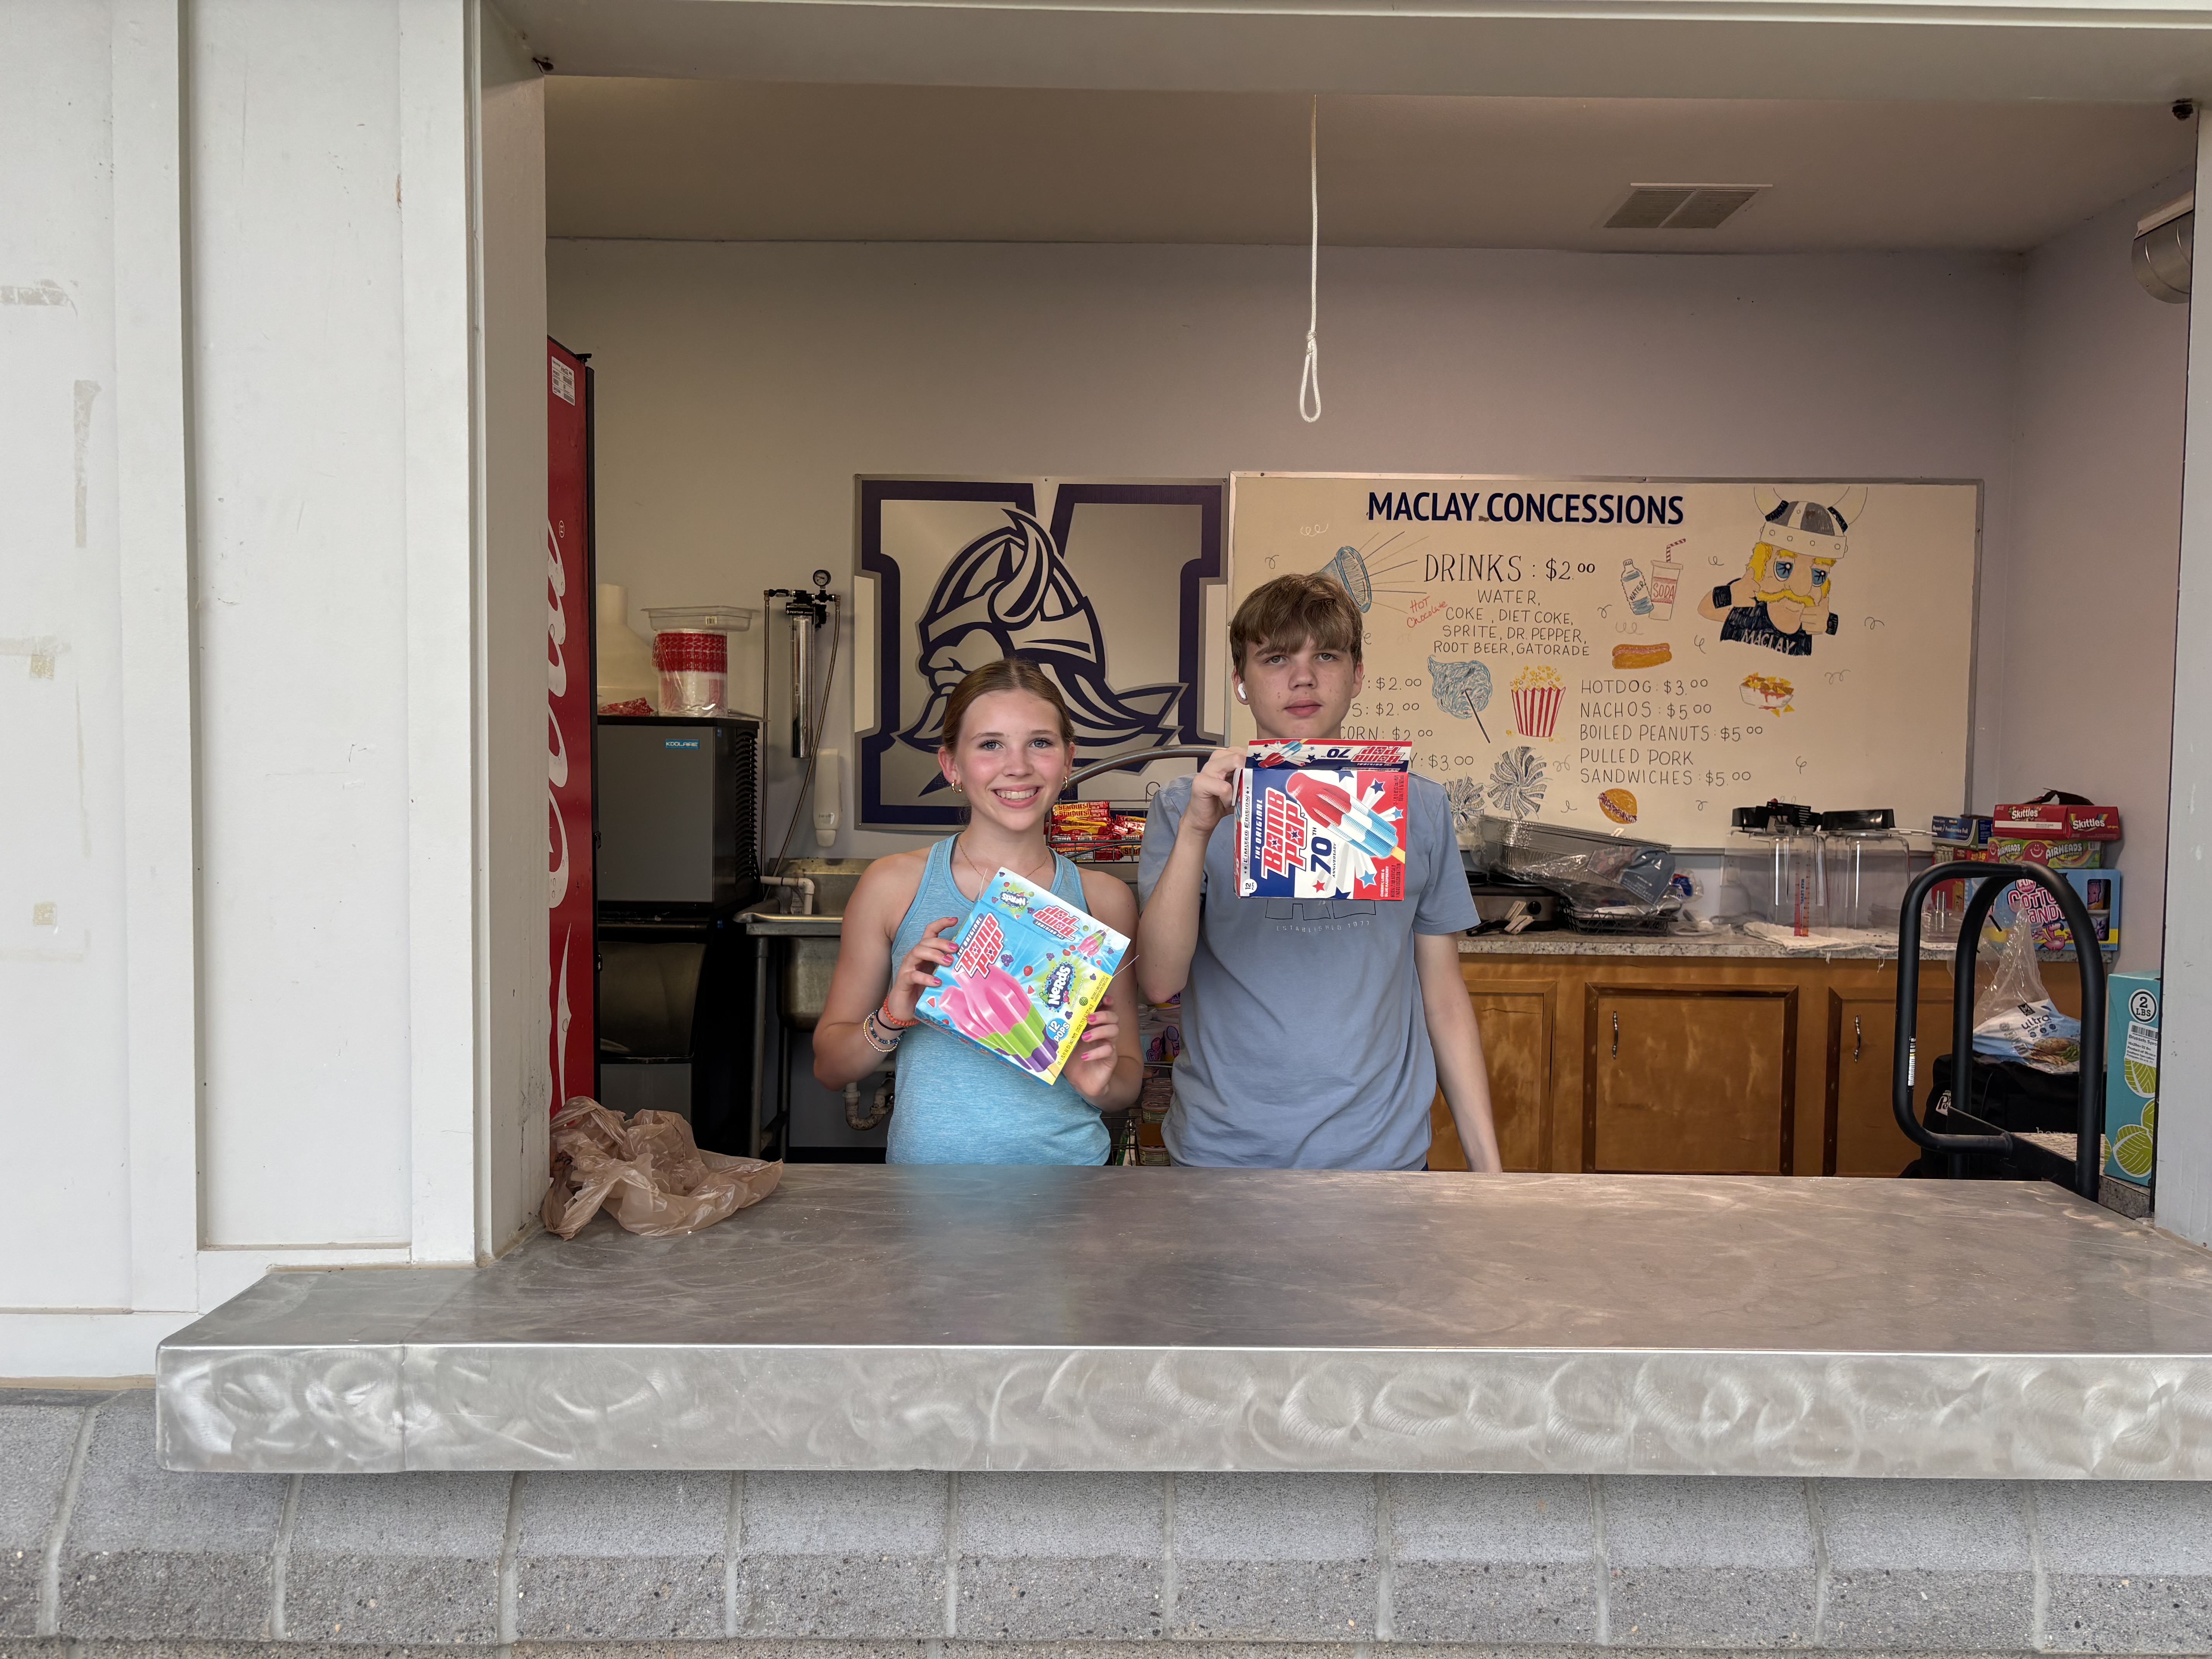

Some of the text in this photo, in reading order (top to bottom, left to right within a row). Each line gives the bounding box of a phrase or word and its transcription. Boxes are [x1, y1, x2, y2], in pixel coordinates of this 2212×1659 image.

[1369, 492, 1683, 524] MACLAY CONCESSIONS
[1629, 581, 1646, 601] WATER
[1653, 582, 1674, 599] SODA
[1410, 596, 1430, 613] HOT
[1407, 600, 1448, 628] Chocolate
[1499, 609, 1530, 623] DIET
[1507, 627, 1528, 640] DR.
[1741, 628, 1796, 654] MACLAY
[1434, 641, 1468, 654] ROOT
[1516, 643, 1589, 656] GATORADE
[1340, 726, 1384, 740] CORN:
[1580, 724, 1632, 741] BOILED
[1352, 754, 1404, 763] BOMB
[1360, 746, 1401, 755] POP
[1580, 748, 1693, 766] PULLED PORK
[2011, 808, 2038, 819] Skittles
[2072, 818, 2105, 830] Skittles
[1263, 789, 1285, 877] BOMB
[1284, 802, 1305, 875] POP
[1997, 844, 2021, 857] AIRHEADS
[2045, 843, 2083, 859] AIRHEADS
[1034, 910, 1076, 941] BOMB
[1044, 907, 1079, 929] POP
[957, 915, 998, 972] BOMB
[970, 929, 1002, 975] POP
[2139, 996, 2148, 1008] 2
[2136, 1008, 2151, 1017] LBS
[1048, 1020, 1061, 1033] 12
[2021, 1014, 2052, 1030] ultra
[1053, 1022, 1070, 1042] POPS
[2129, 1034, 2147, 1043] Brussels
